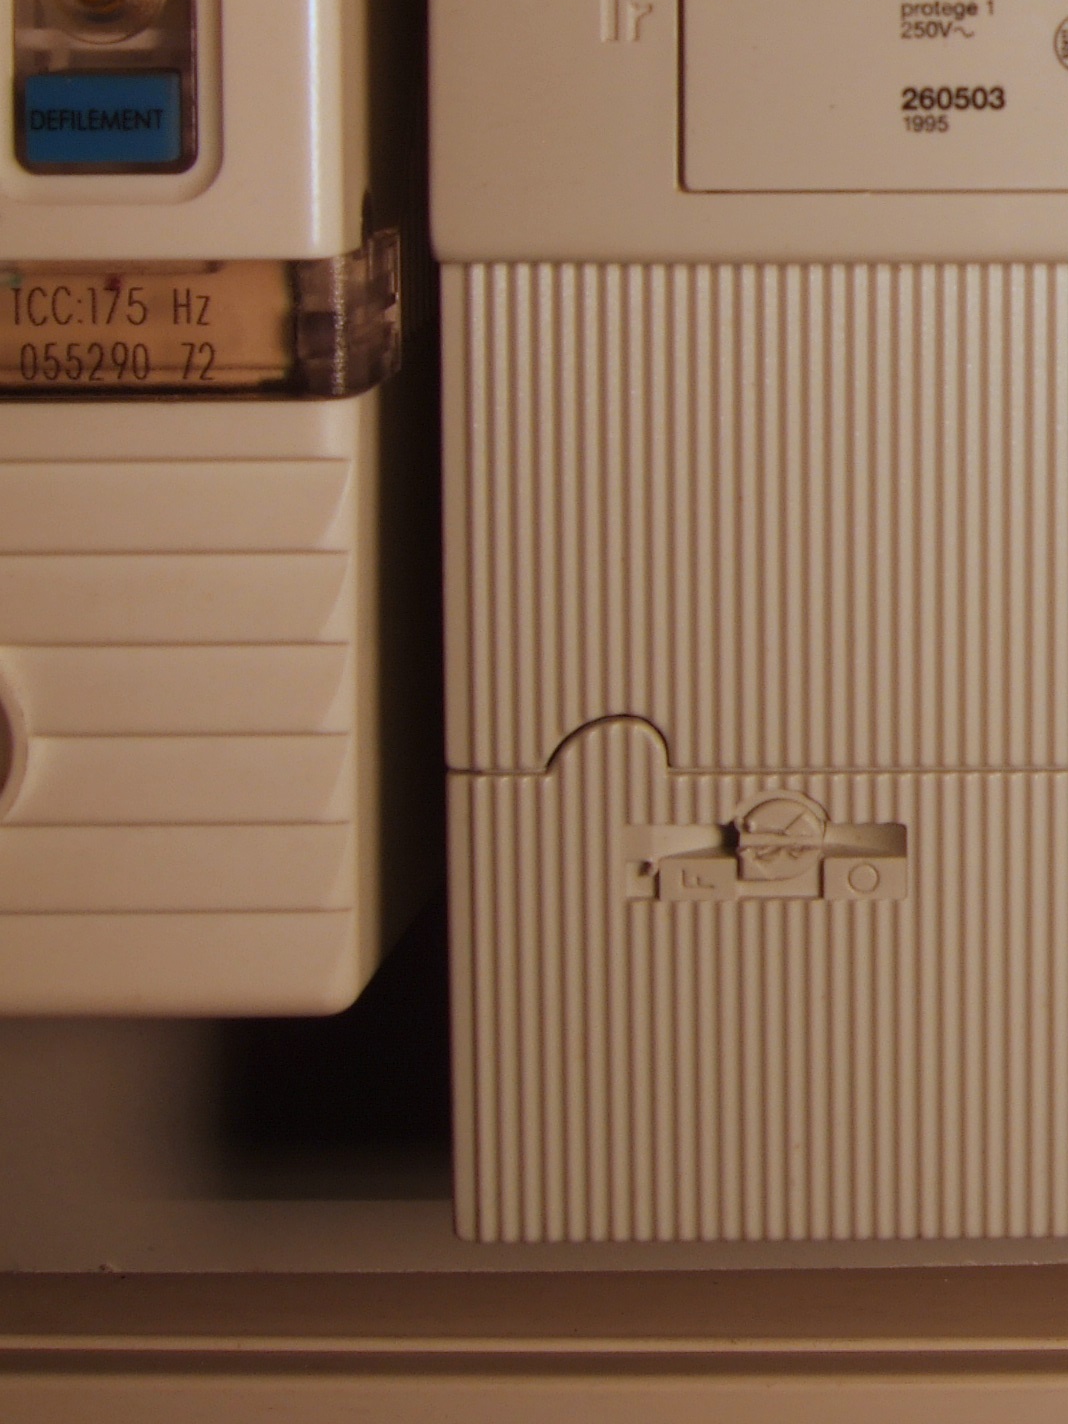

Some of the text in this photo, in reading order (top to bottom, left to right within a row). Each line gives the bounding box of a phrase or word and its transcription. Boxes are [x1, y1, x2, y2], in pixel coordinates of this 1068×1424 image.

[986, 0, 995, 16] 1
[902, 86, 1006, 111] 260503
[30, 110, 163, 131] DEFILEMENT
[903, 115, 950, 133] 1995
[172, 288, 211, 326] Hz
[20, 342, 216, 381] 055290 72
